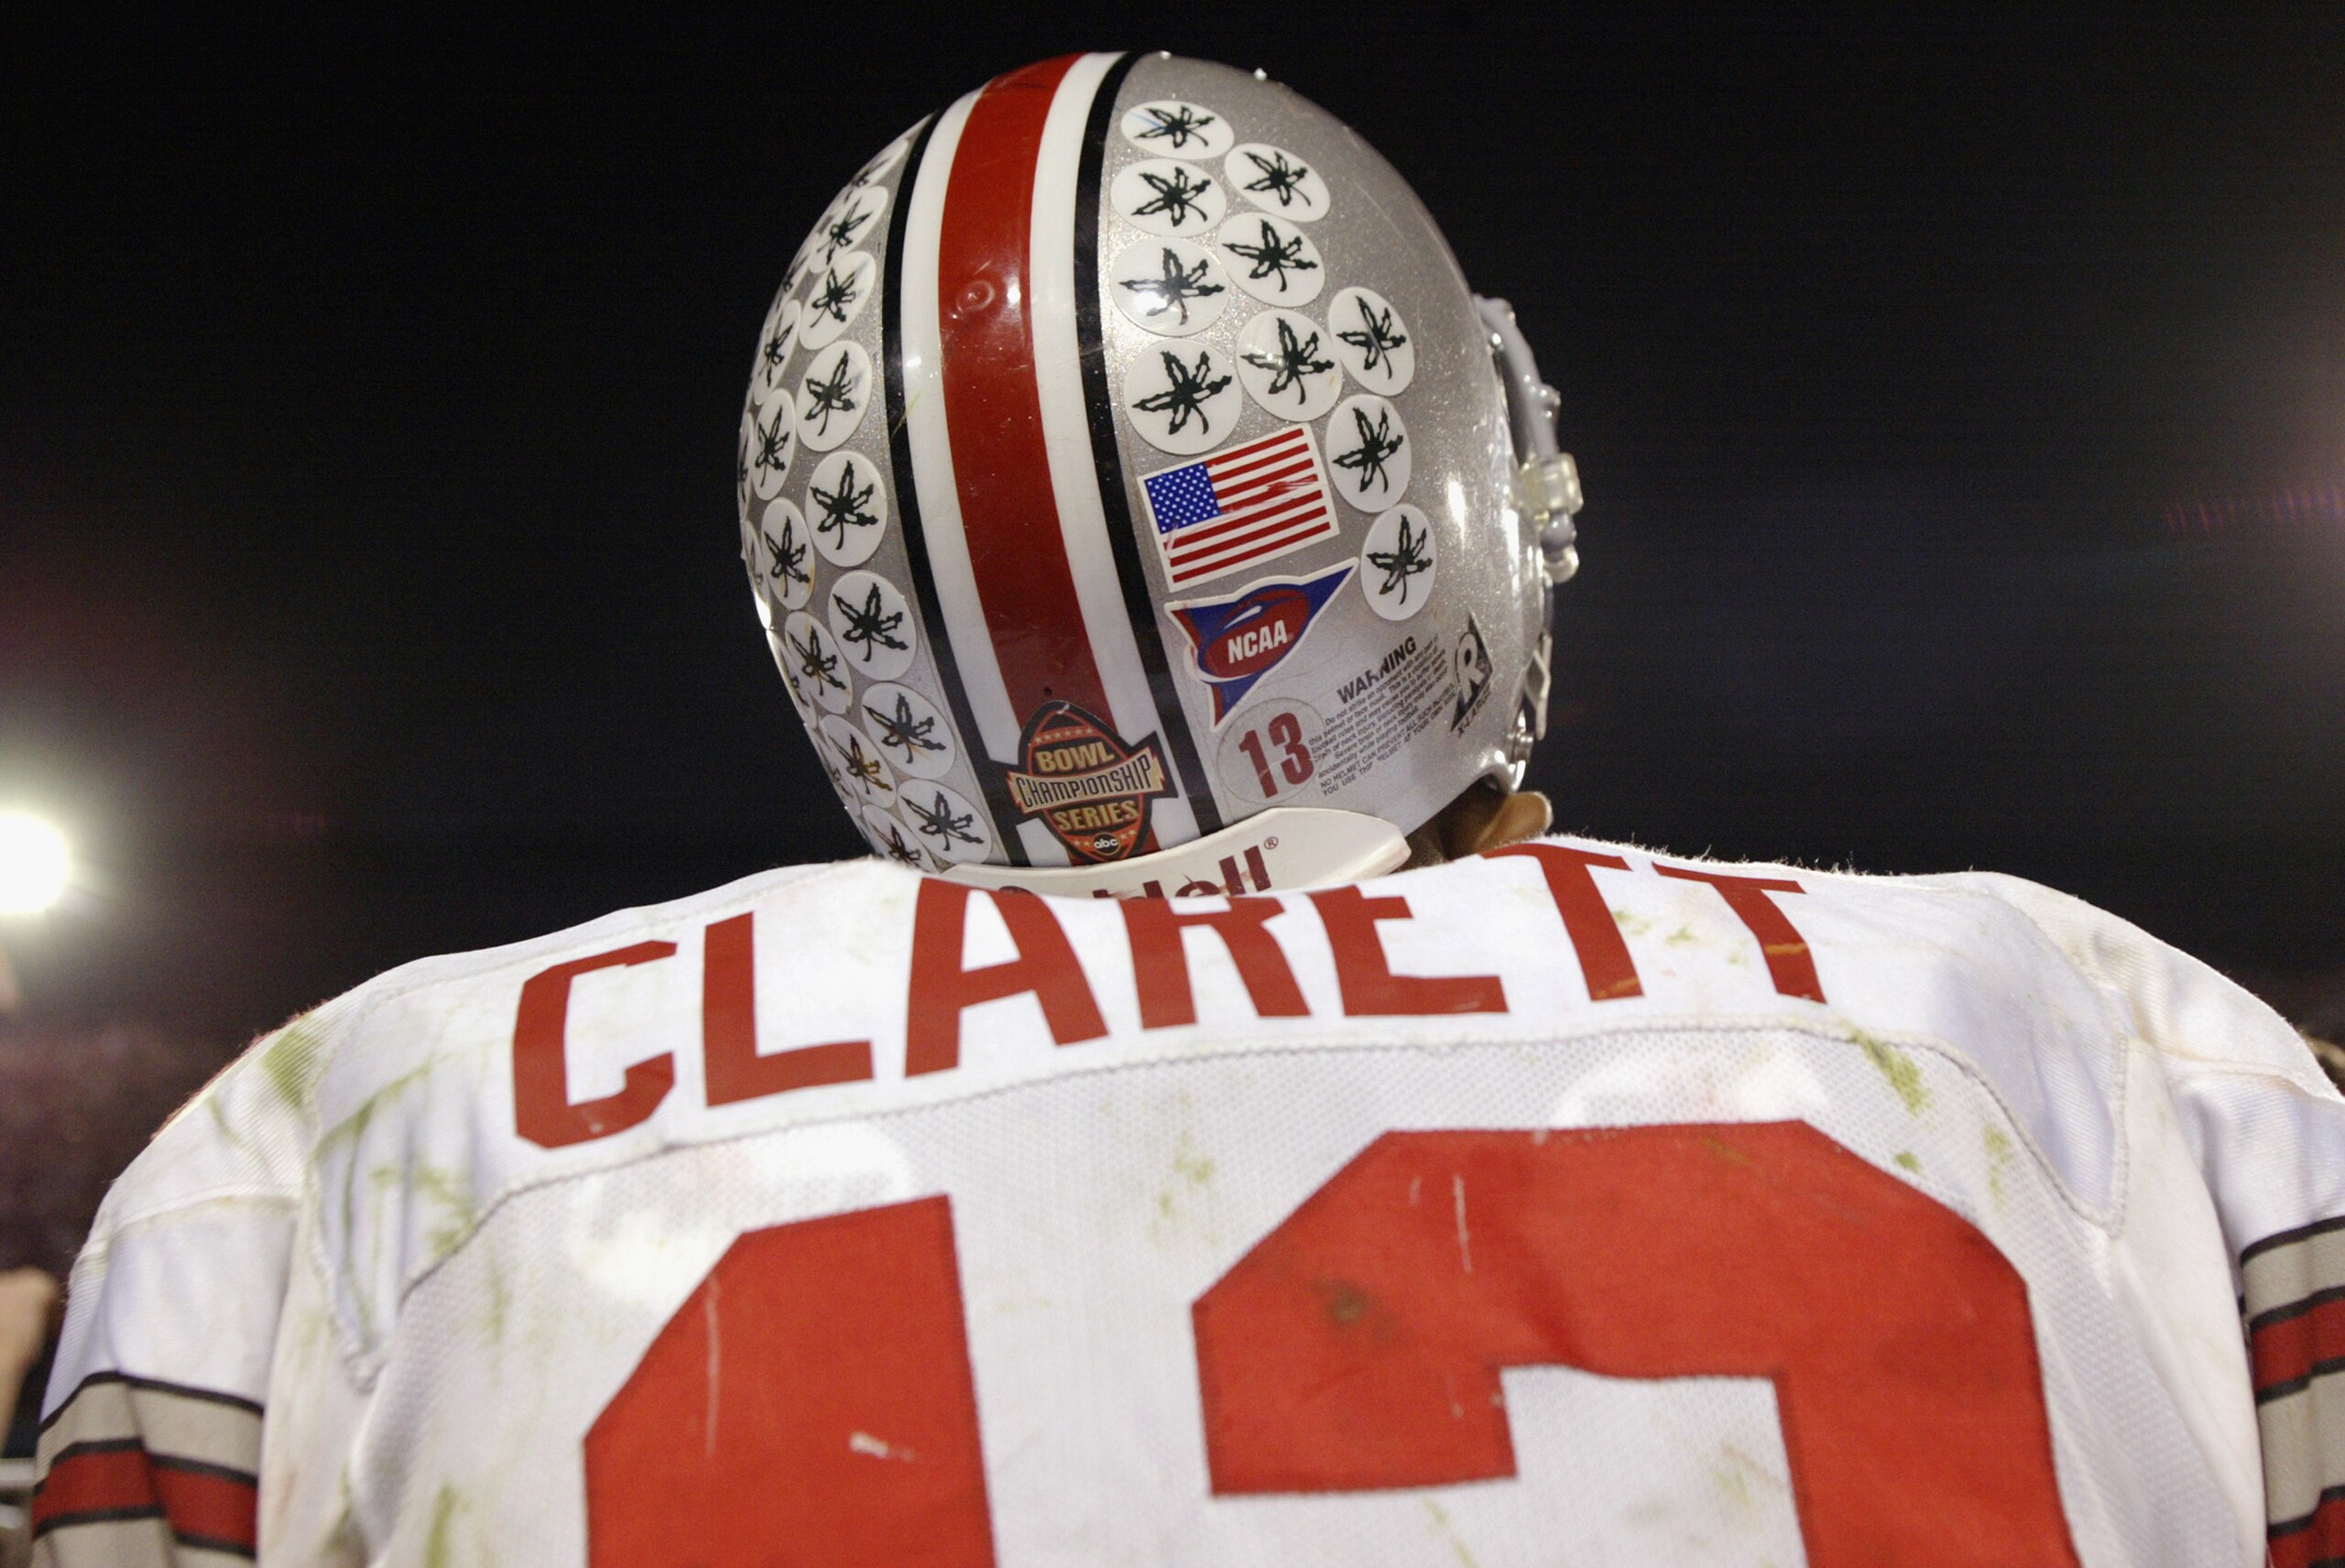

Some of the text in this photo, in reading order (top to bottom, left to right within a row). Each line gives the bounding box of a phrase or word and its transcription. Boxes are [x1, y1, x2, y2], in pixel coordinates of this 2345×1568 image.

[1227, 620, 1288, 664] NCAA
[1036, 742, 1116, 773] BOWL
[1238, 713, 1314, 798] 13
[1016, 755, 1151, 808] CHAMPIONSHIP
[1053, 800, 1139, 831] SERIES
[1094, 837, 1118, 850] abc
[514, 842, 1827, 1149] CLARETT
